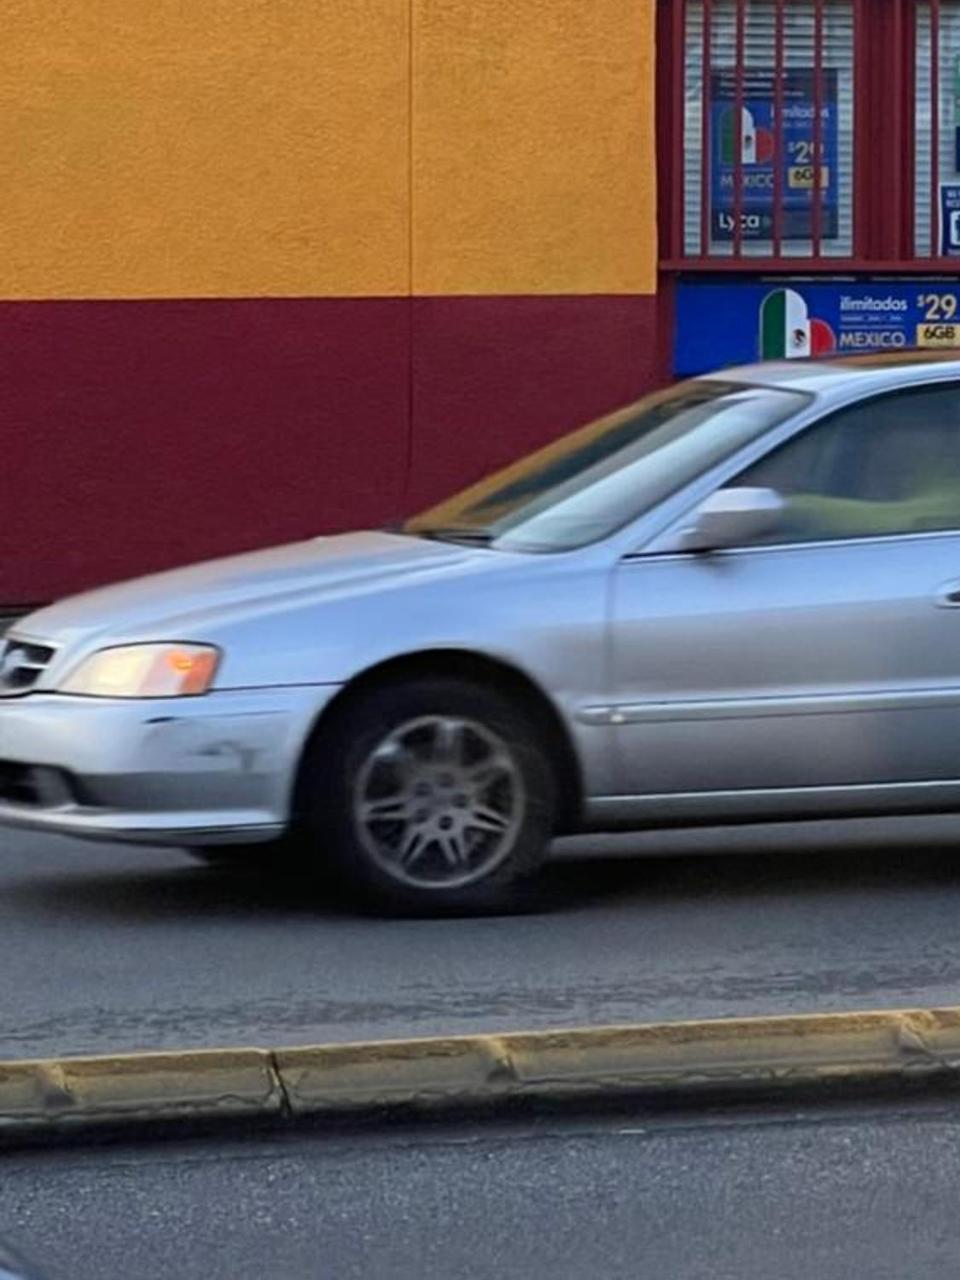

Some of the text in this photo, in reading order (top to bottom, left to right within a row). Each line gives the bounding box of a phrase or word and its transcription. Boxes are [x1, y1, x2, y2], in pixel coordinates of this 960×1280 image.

[916, 293, 957, 320] $29
[840, 331, 906, 348] MEXICO
[923, 325, 956, 340] 6GB
